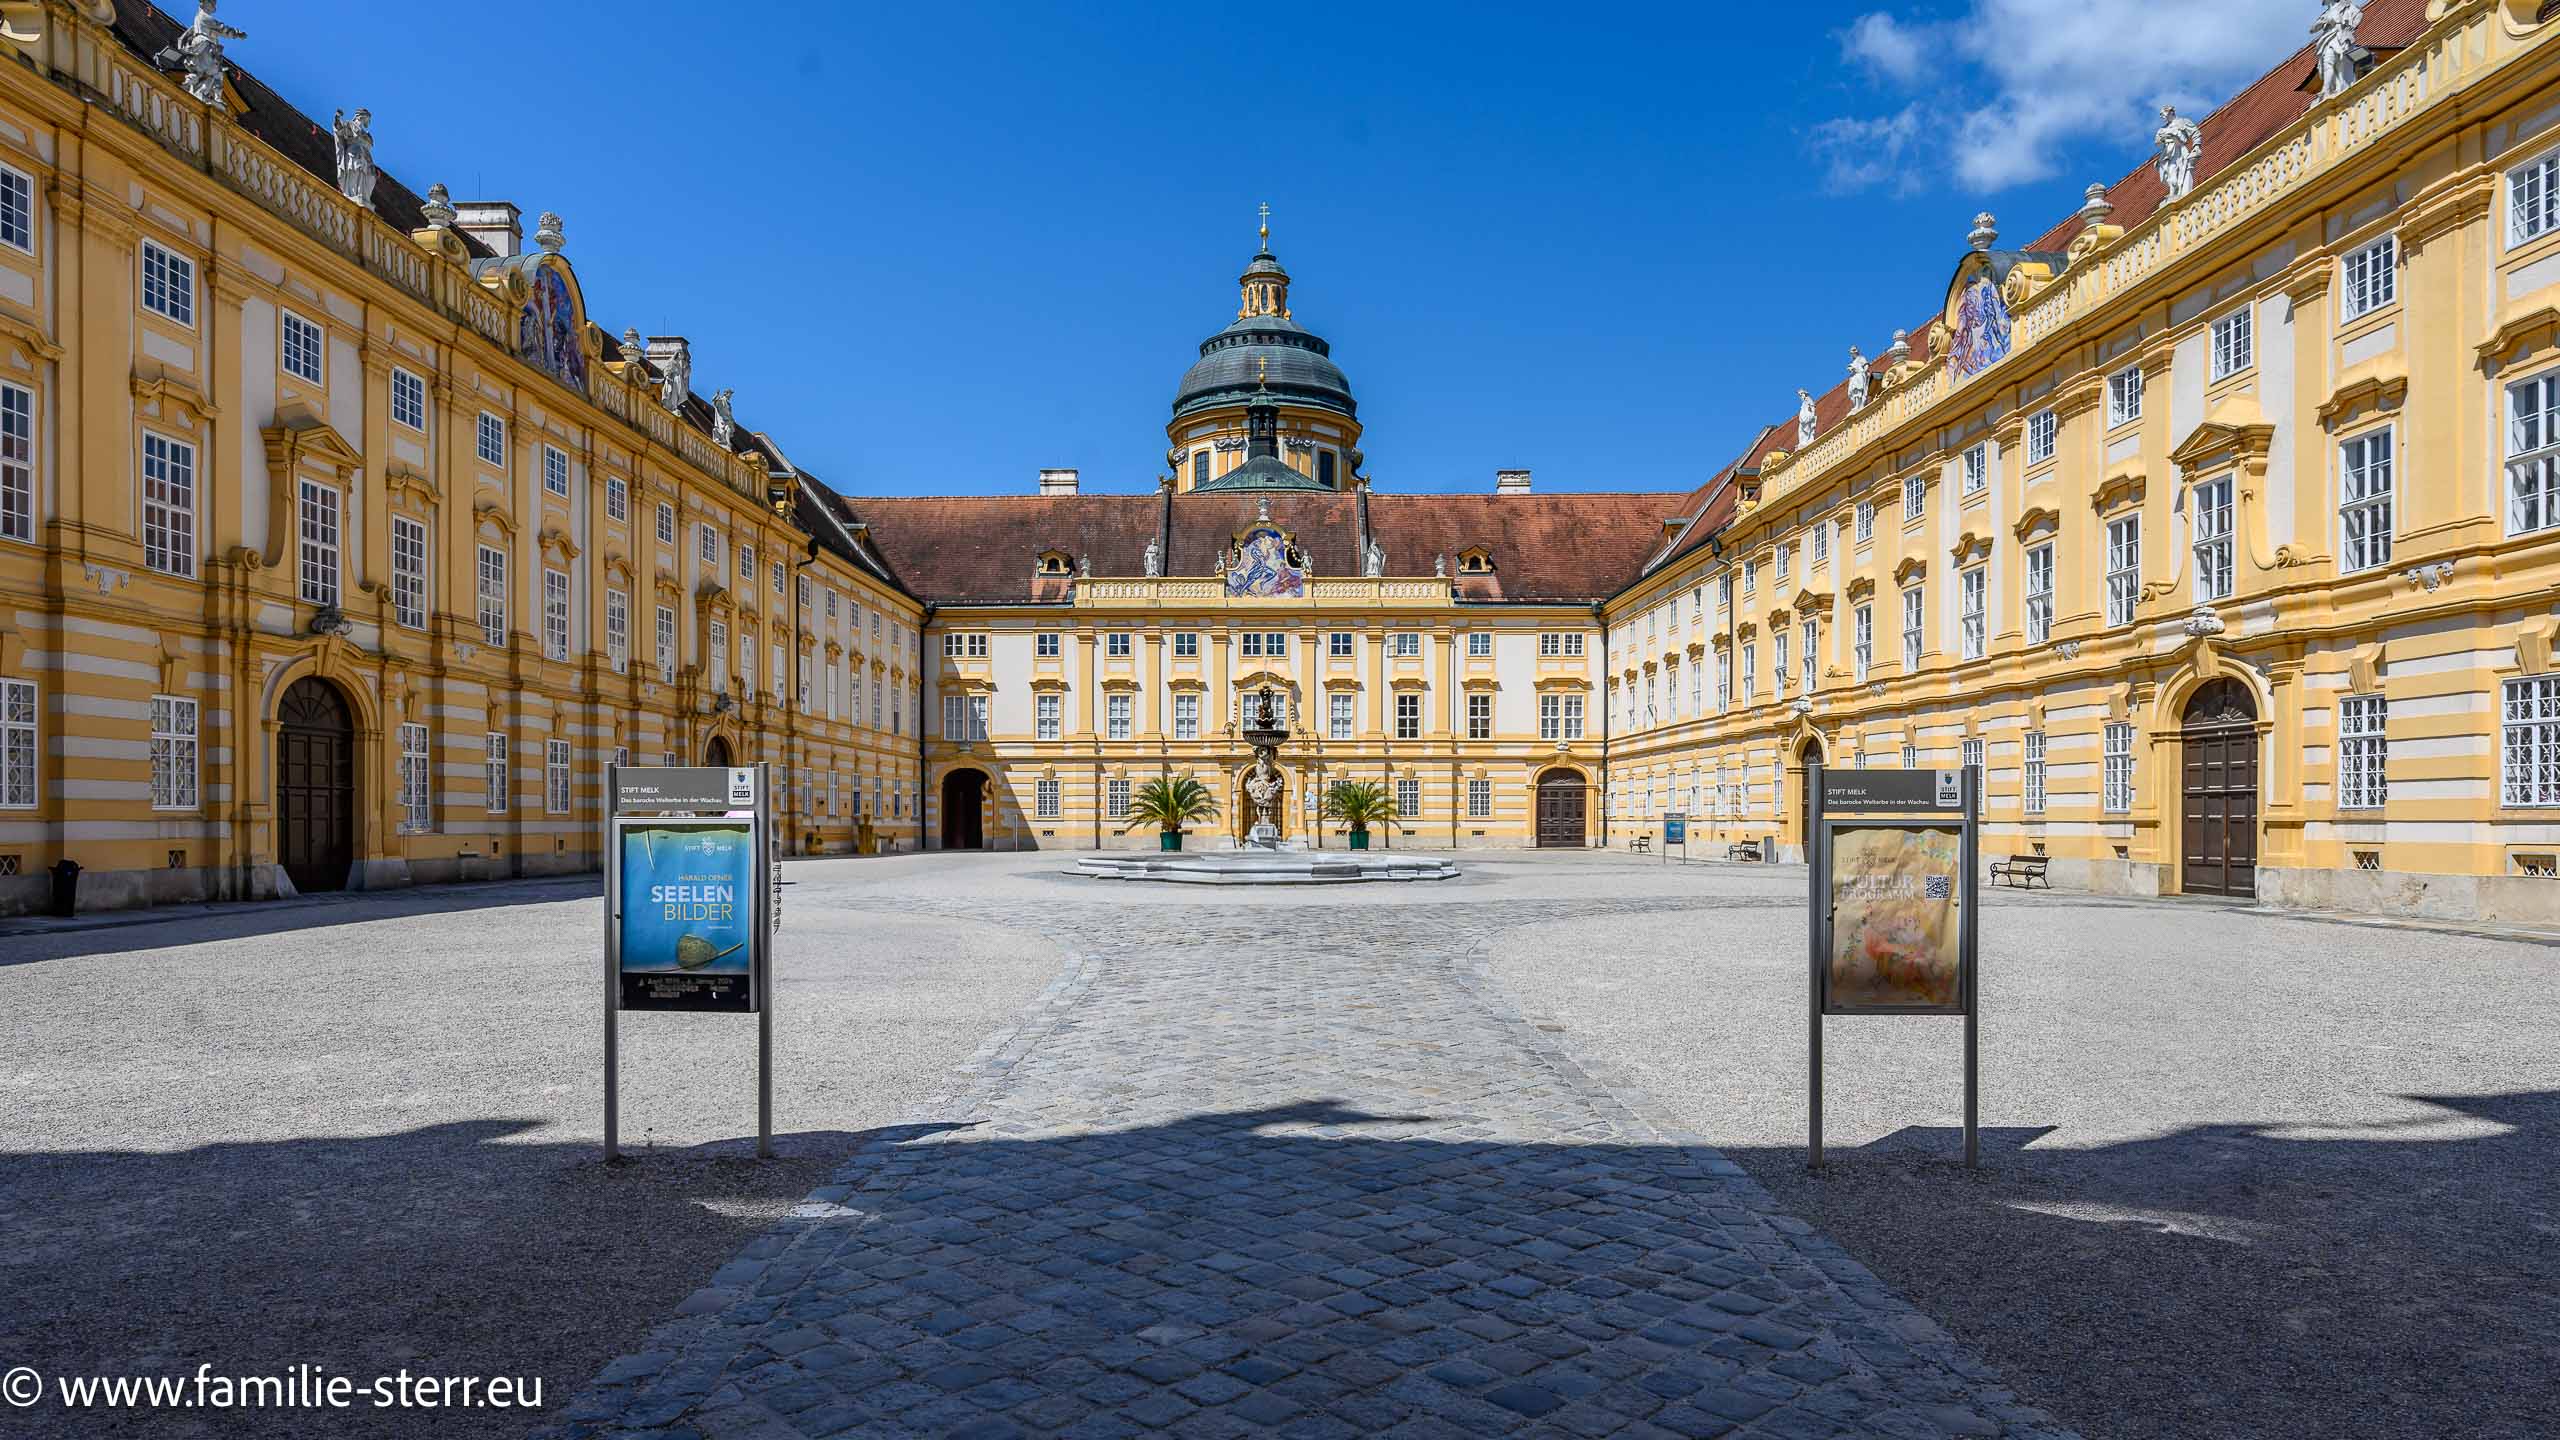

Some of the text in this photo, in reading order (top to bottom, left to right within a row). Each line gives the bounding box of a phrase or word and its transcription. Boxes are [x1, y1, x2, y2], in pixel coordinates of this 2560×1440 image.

[1827, 788, 1867, 796] STIFT MELK
[1842, 874, 1914, 889] KULTUR
[651, 885, 733, 902] SEELEN
[1840, 890, 1914, 900] PROGRAMM
[664, 903, 733, 921] BILDER
